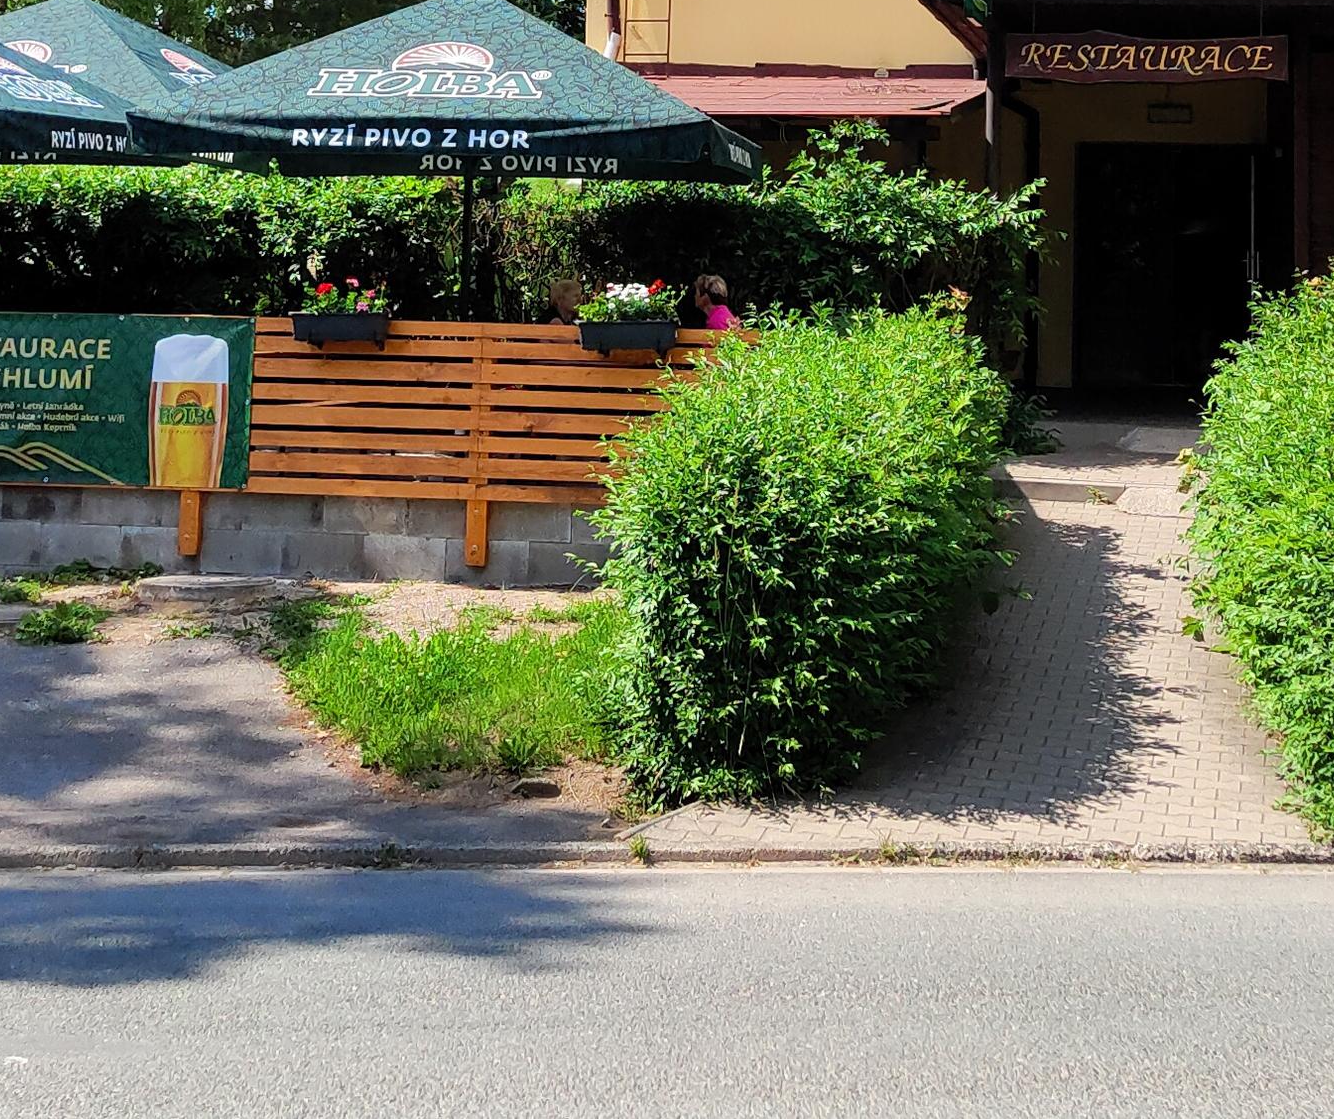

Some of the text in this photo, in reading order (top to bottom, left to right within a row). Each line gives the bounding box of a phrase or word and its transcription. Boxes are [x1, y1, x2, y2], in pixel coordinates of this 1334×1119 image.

[1018, 42, 1273, 76] RESTAURACE
[307, 67, 543, 99] HOLBA
[51, 127, 75, 149] RYZÍ
[78, 131, 104, 150] PIVO
[106, 134, 114, 152] Z
[291, 124, 530, 149] RYZÍ PIVO Z HOR
[158, 405, 216, 426] HOLBA
